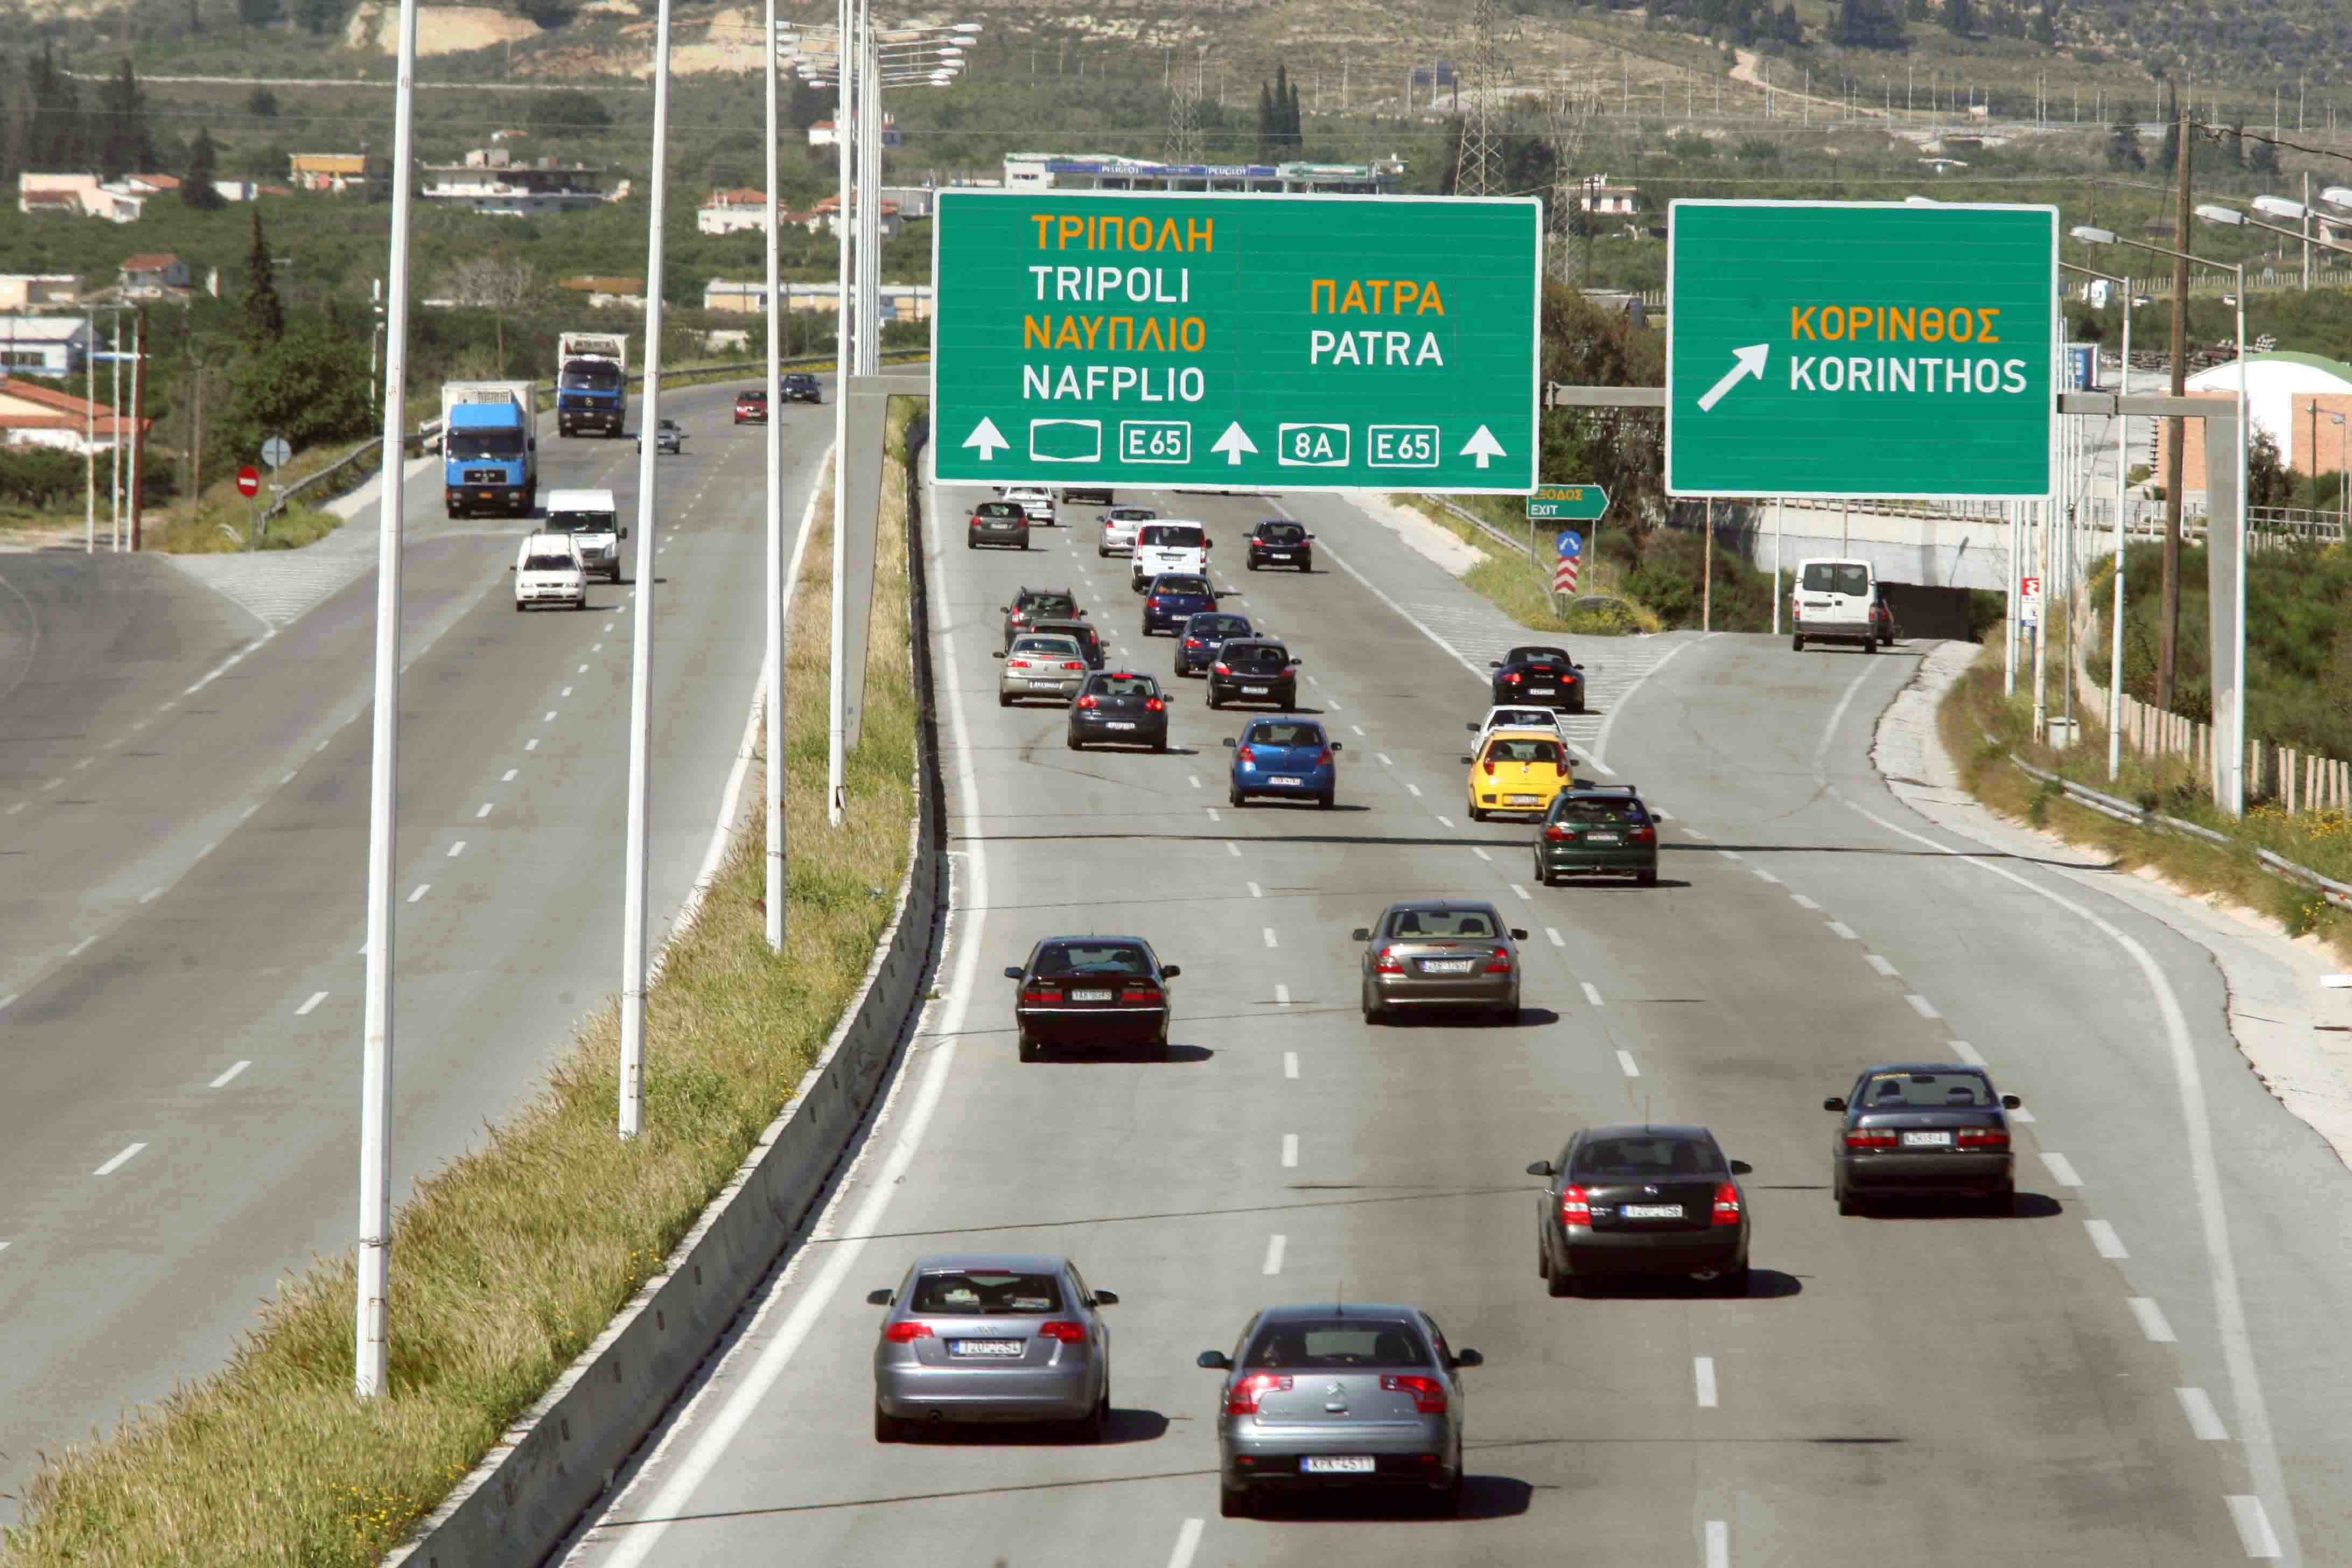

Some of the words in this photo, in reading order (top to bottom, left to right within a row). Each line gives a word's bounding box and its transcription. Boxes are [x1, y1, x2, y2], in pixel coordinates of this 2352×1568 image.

[1102, 165, 1139, 173] PEUGEOT
[1208, 166, 1248, 176] PEUGEOT
[1031, 215, 1213, 252] ΤΡΙΠΟΛΗ
[1029, 266, 1188, 303] TRIPOLI
[1311, 279, 1444, 316] ΠΑΤΡΑ
[1024, 315, 1206, 352] ΝΑΥΠΛΙΟ
[1791, 305, 2000, 343] ΚΟΡΙΝΘΟΣ
[1311, 330, 1444, 366] PATRA
[1024, 365, 1205, 402] NAFPLIO
[1790, 356, 2026, 394] KORINTHOS
[1294, 432, 1333, 459] 8A
[1531, 504, 1558, 515] EXIT
